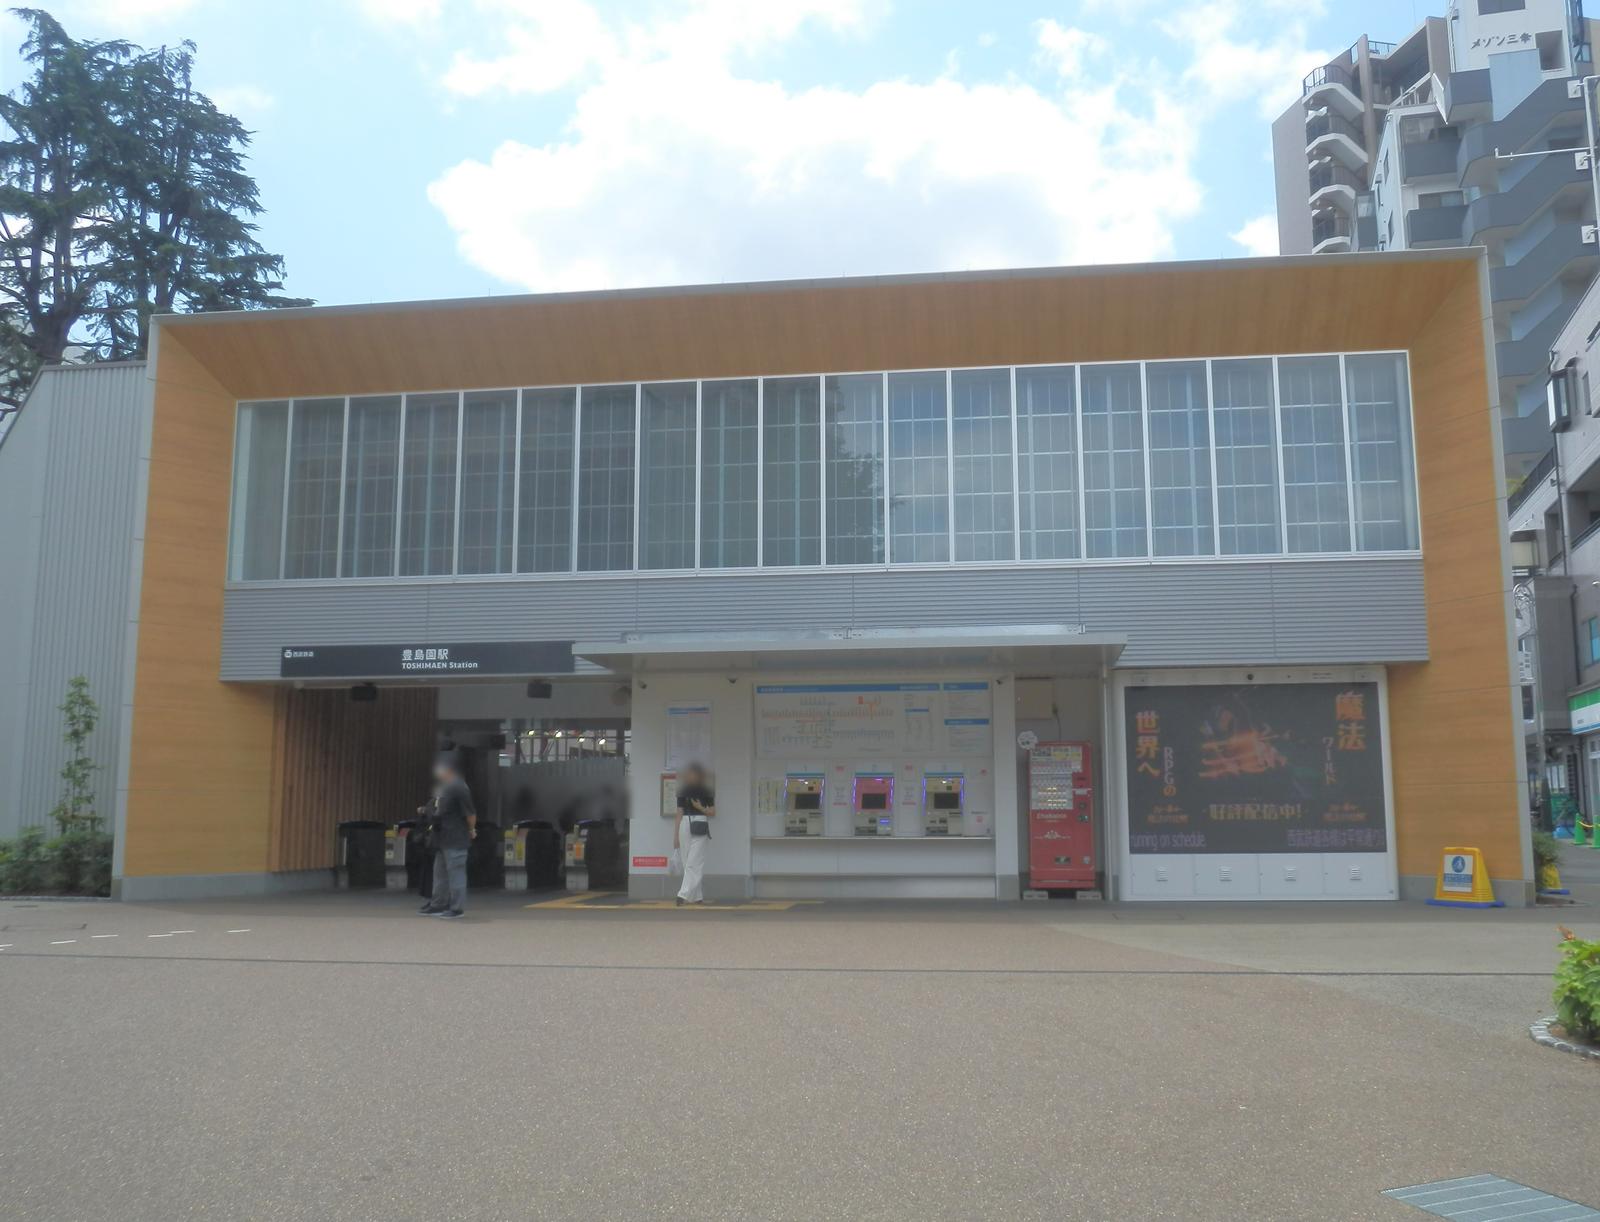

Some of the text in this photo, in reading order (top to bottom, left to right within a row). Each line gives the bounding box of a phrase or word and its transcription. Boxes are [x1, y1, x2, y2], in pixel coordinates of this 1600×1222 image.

[402, 648, 449, 661] 豊島園駅
[402, 661, 478, 670] TOSHIMAEN Station
[1136, 710, 1161, 779] 世界へ
[1336, 690, 1366, 752] 魔法
[1163, 746, 1177, 797] RPGの
[1322, 736, 1337, 784] ワールド
